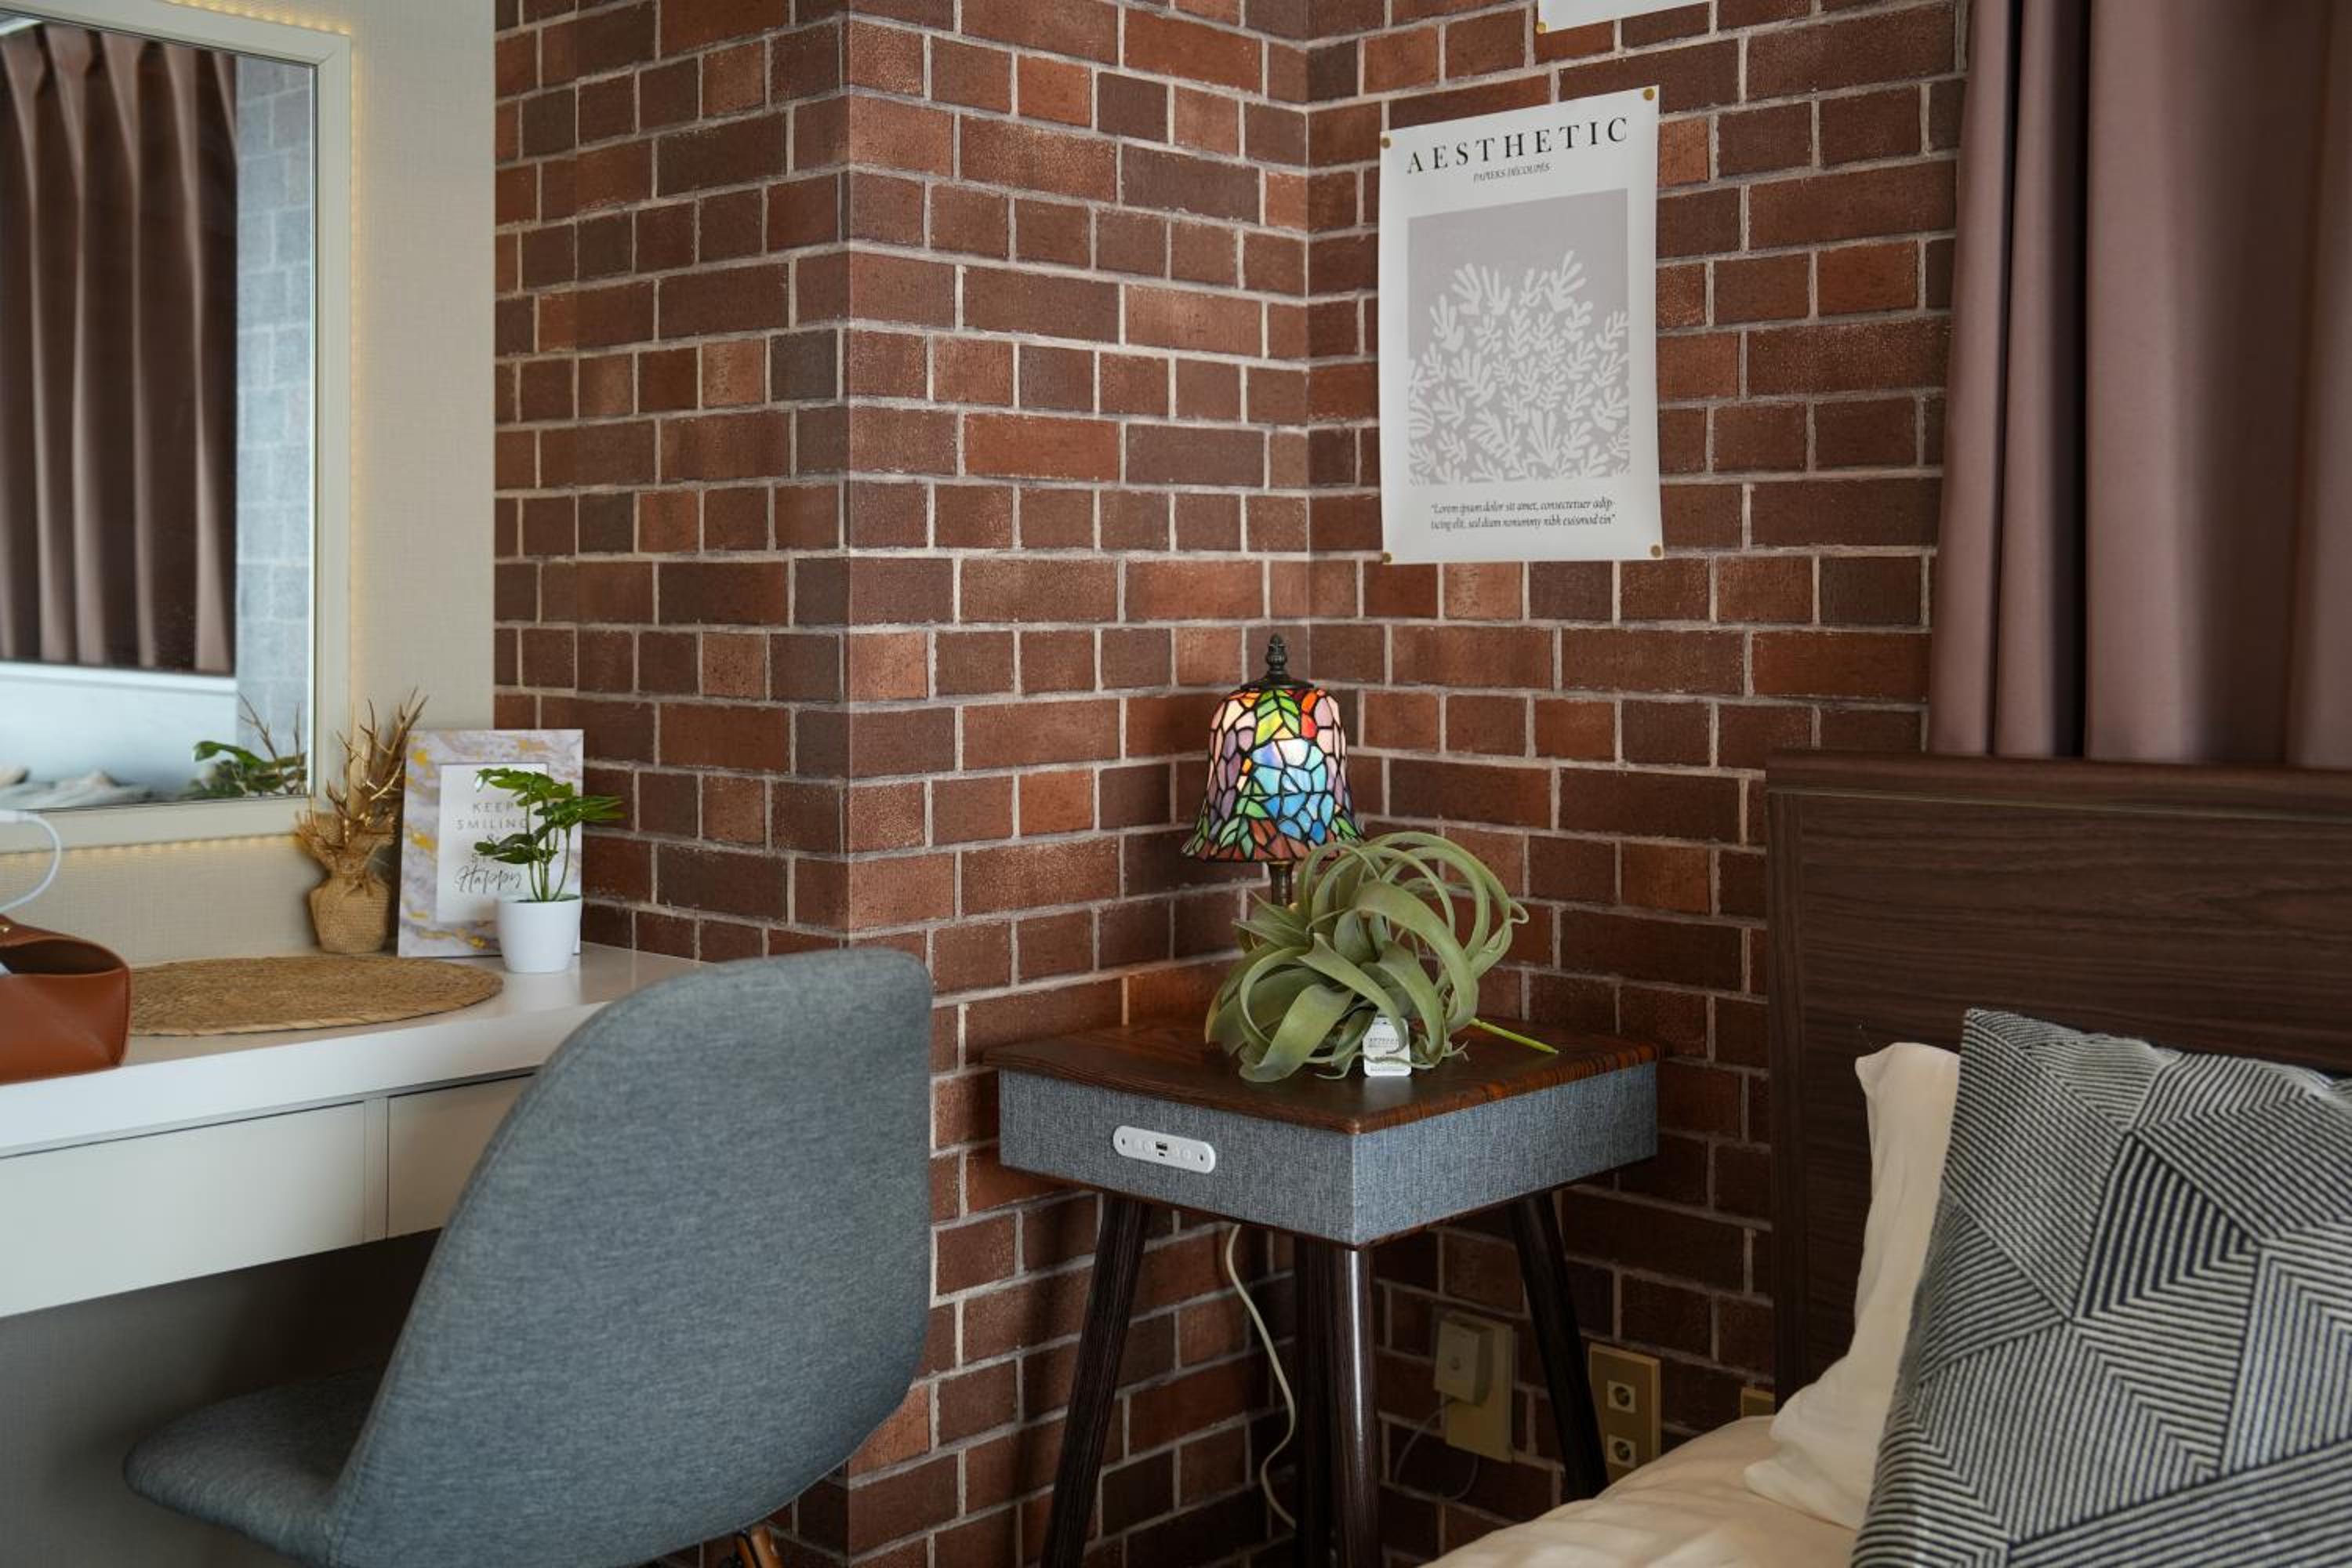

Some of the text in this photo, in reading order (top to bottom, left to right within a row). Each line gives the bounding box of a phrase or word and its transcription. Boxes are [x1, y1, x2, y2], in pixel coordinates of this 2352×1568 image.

[1406, 117, 1628, 174] AESTHETIC
[1483, 500, 1504, 513] dolor
[1506, 502, 1515, 512] sit
[473, 802, 514, 813] KEEP
[455, 865, 521, 894] Happy
